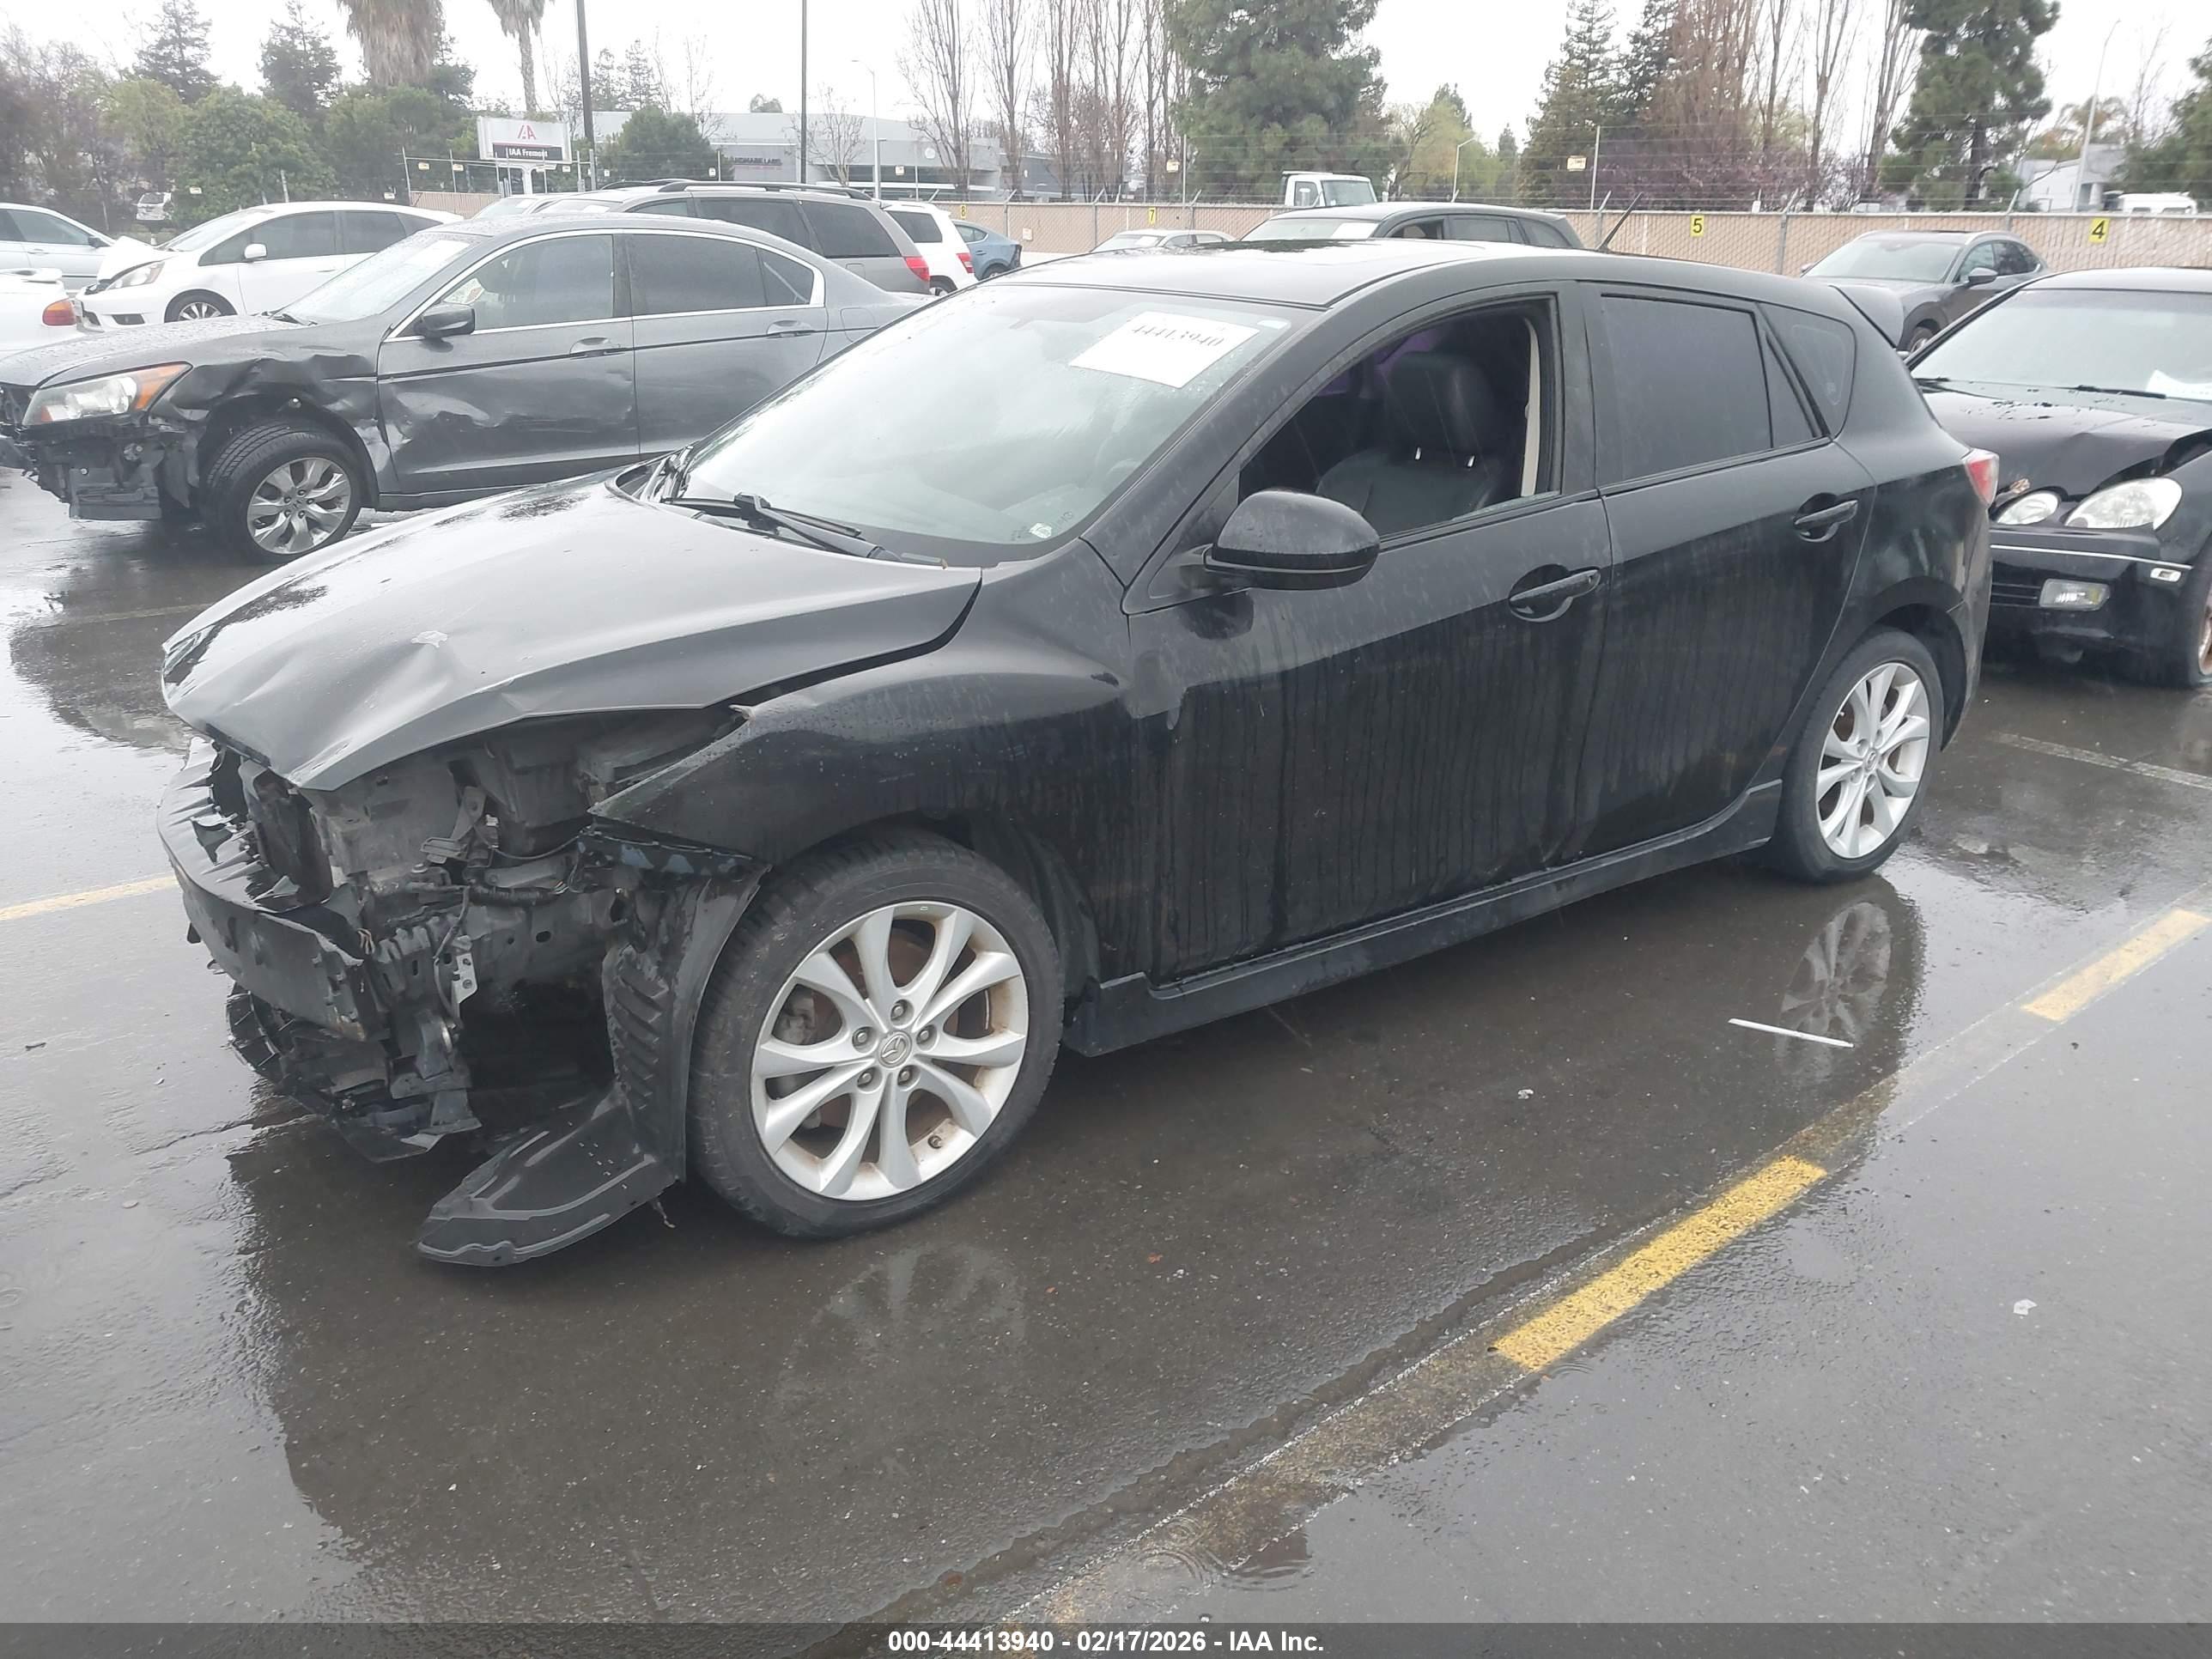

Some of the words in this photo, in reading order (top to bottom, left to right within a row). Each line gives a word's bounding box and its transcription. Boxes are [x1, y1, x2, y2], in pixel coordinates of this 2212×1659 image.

[508, 148, 522, 156] IAA
[523, 149, 548, 158] Fremont
[1149, 209, 1156, 222] 7
[1692, 217, 1703, 234] 5
[2091, 219, 2106, 240] 4
